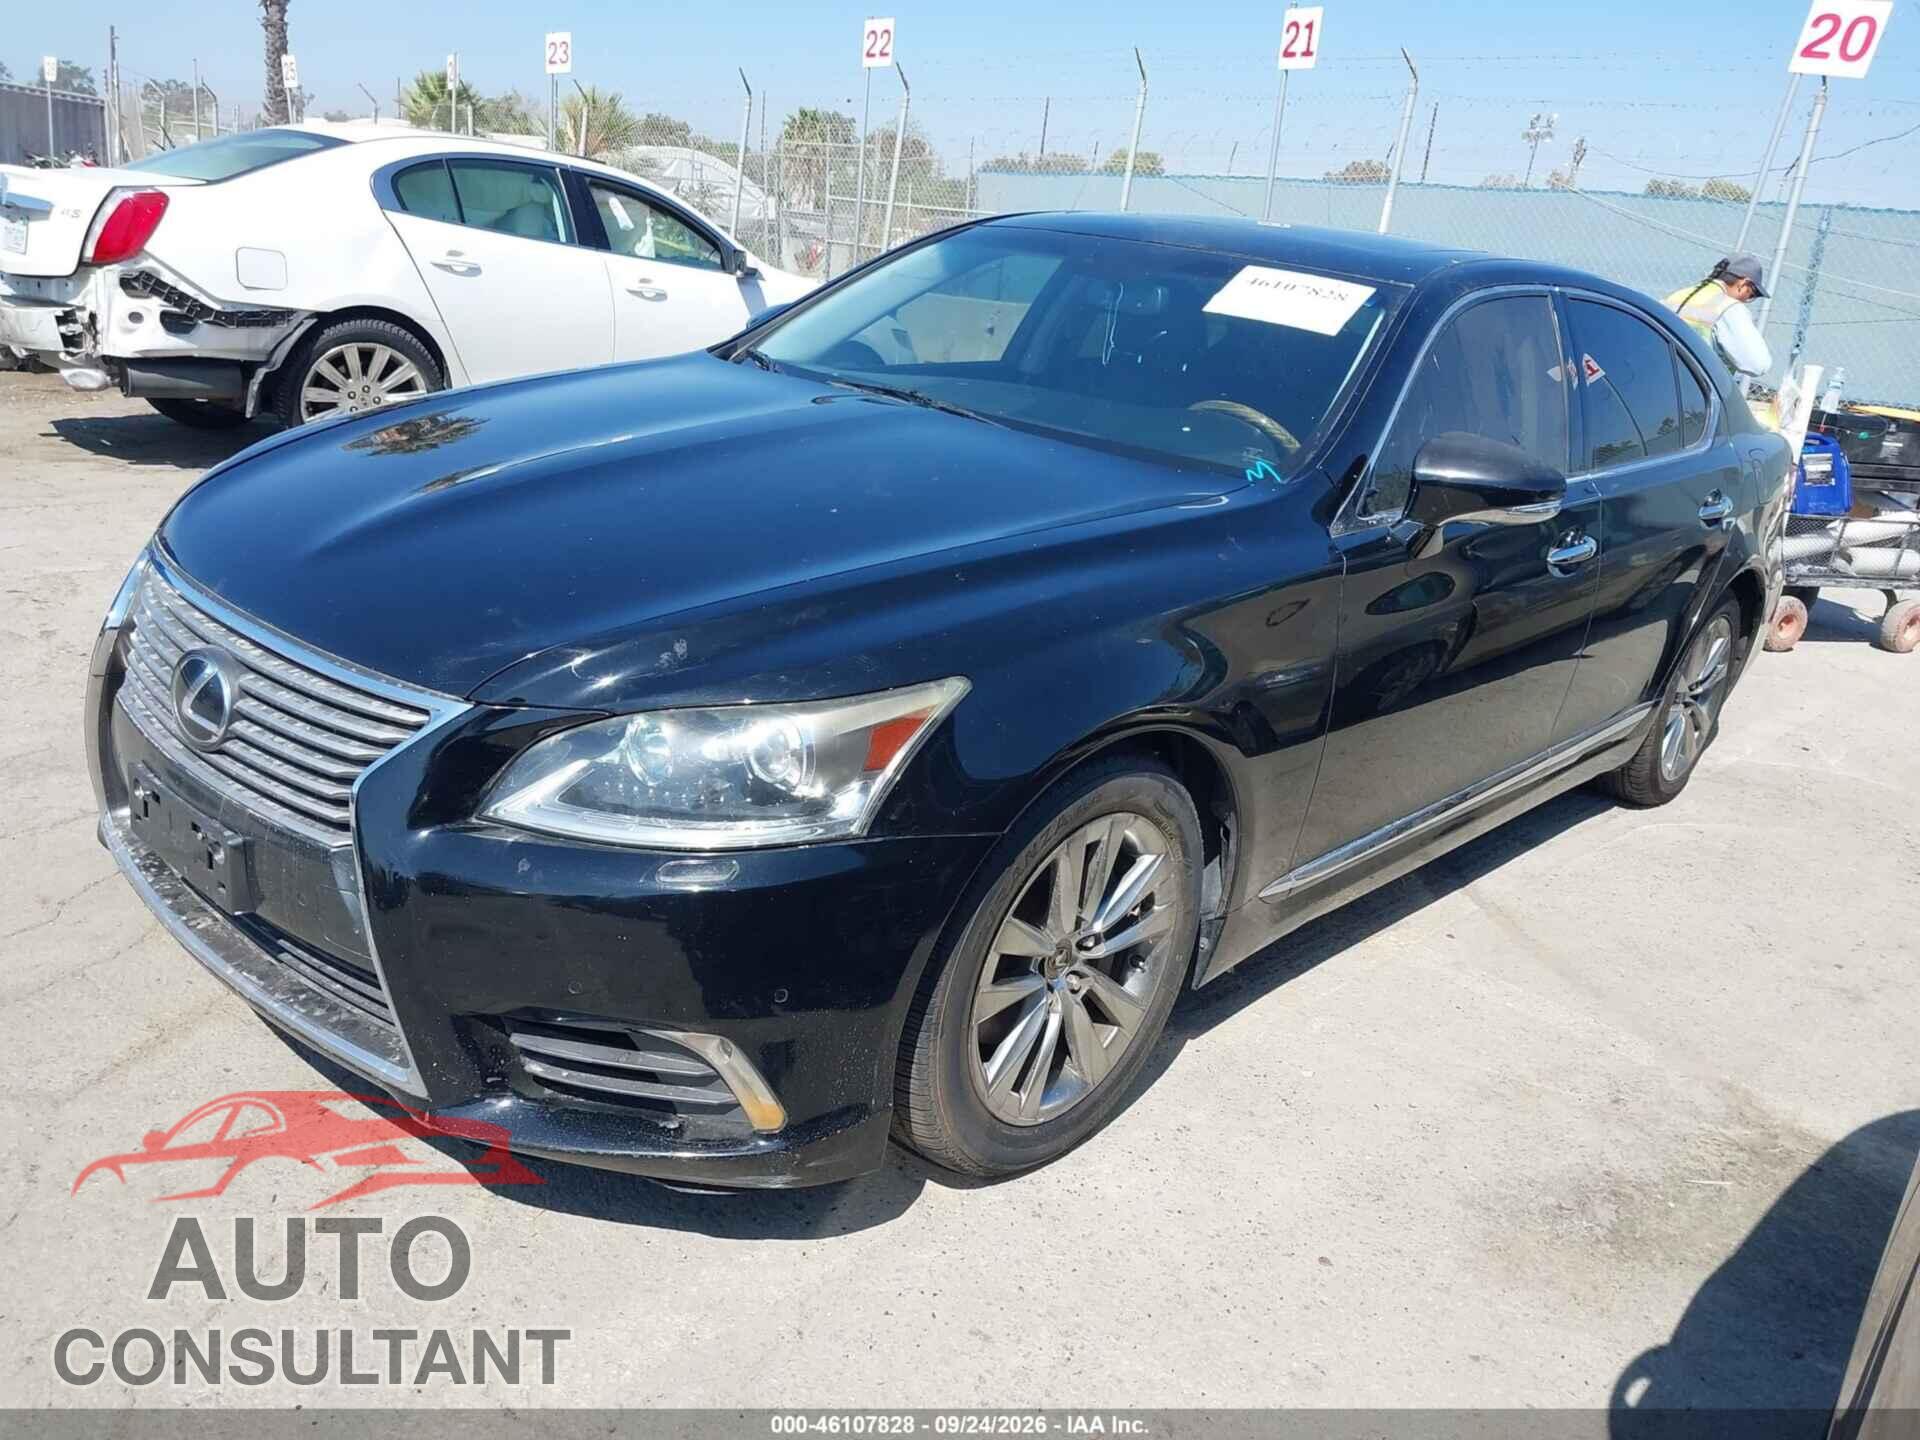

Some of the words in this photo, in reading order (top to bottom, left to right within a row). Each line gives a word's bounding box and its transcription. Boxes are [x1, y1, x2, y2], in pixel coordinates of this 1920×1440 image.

[548, 41, 569, 64] 23
[866, 29, 891, 58] 22
[1282, 20, 1314, 58] 21
[1799, 12, 1877, 62] 20
